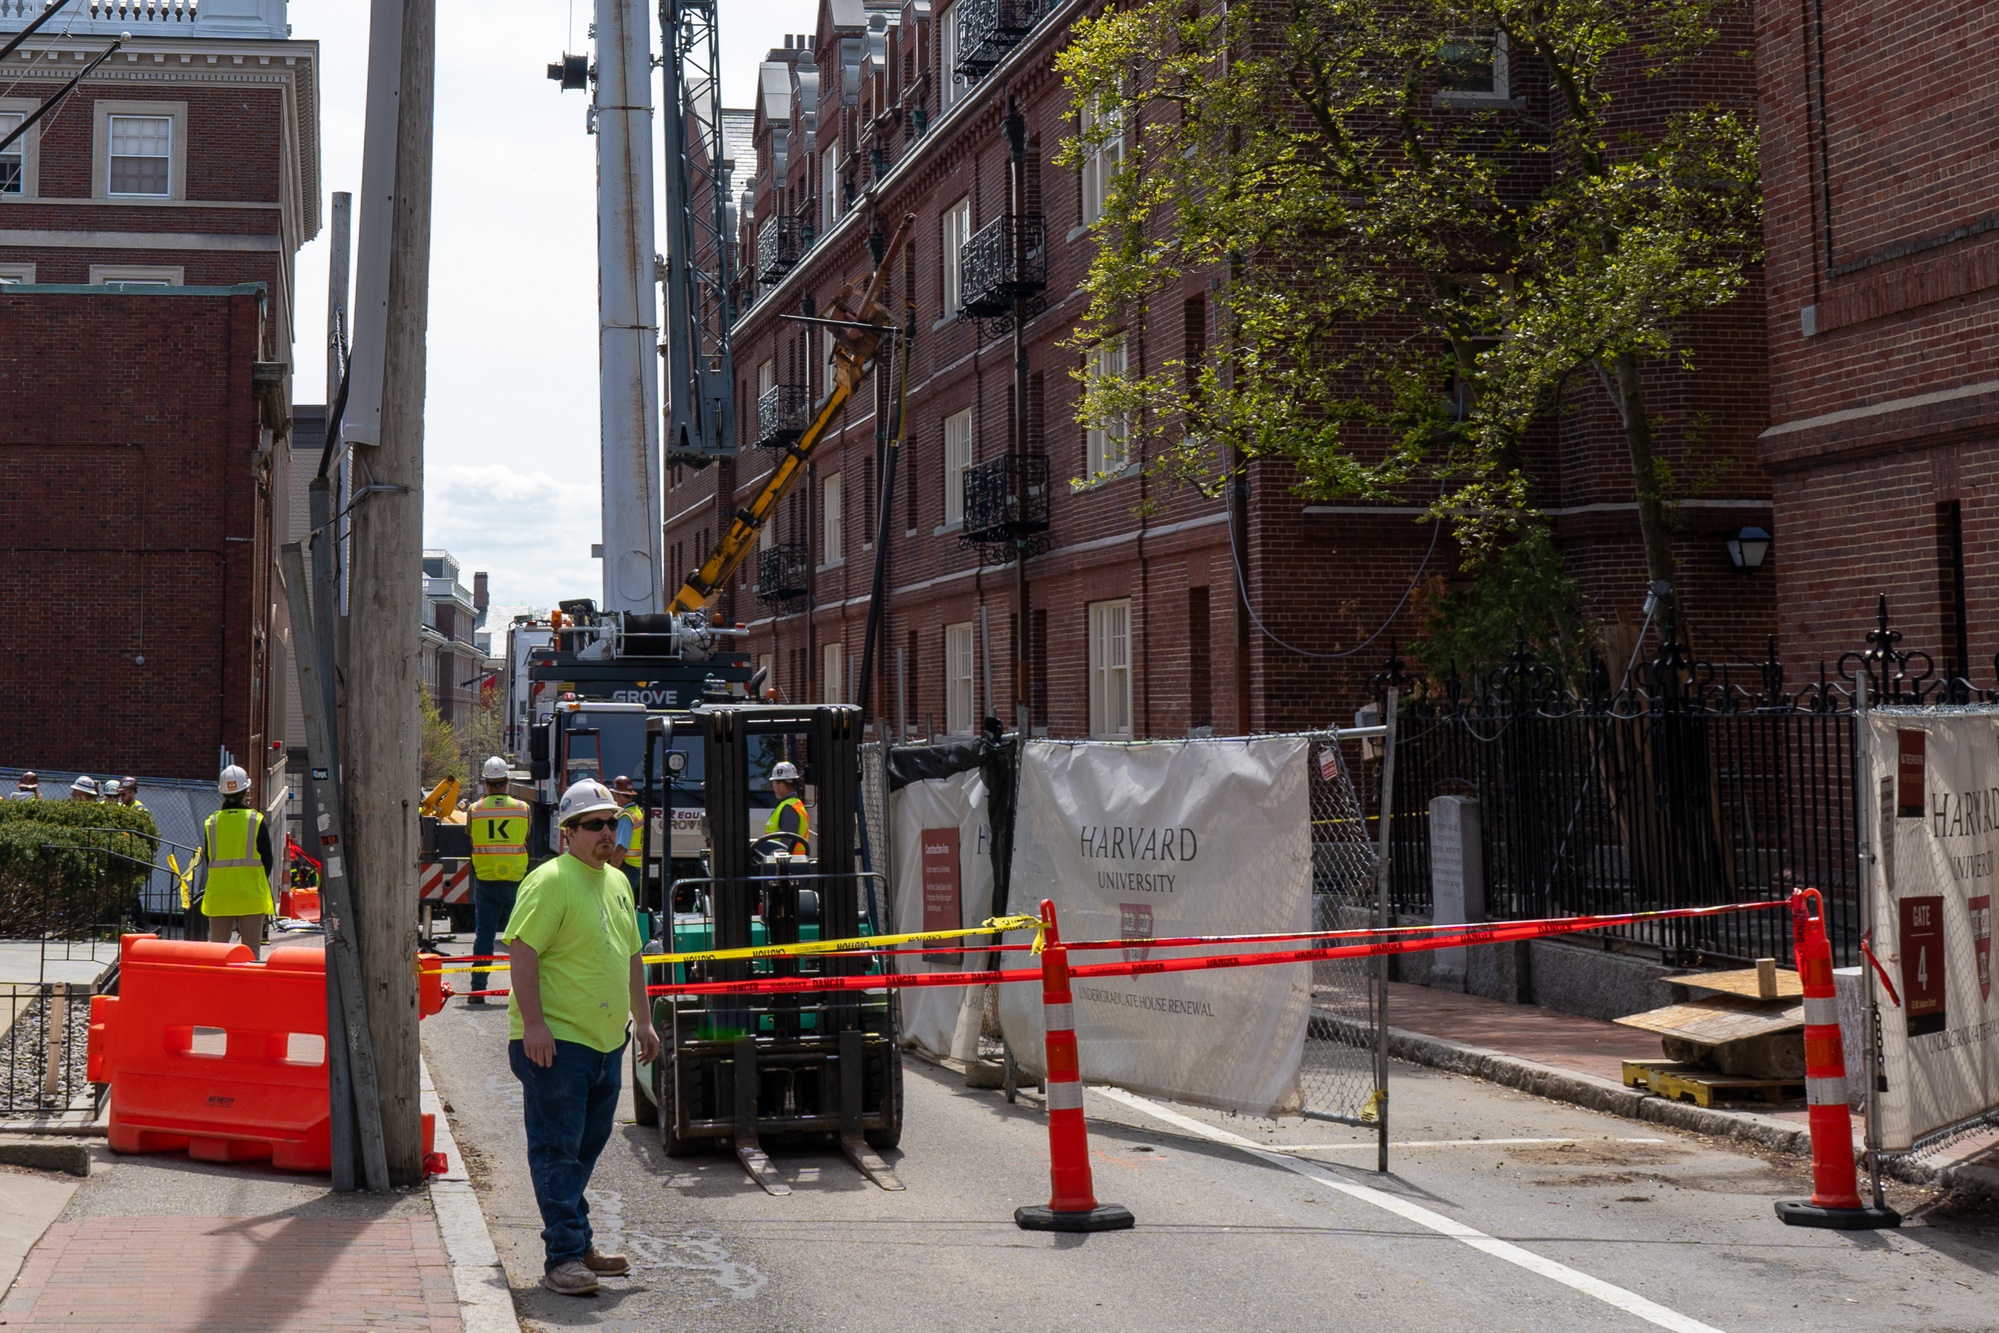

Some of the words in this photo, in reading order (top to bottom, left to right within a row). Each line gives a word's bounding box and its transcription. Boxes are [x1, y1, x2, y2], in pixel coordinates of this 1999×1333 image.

[612, 690, 677, 705] GROVE
[1080, 826, 1198, 861] HARVARD
[1097, 871, 1176, 893] UNIVERSITY
[1912, 905, 1931, 927] GATE
[726, 982, 759, 992] DANGER
[812, 978, 845, 989] DANGER
[885, 975, 918, 987] DANGER
[971, 971, 1004, 983] DANGER
[1370, 942, 1405, 954] DANGER
[1460, 932, 1496, 944] DANGER
[1537, 923, 1573, 935] DANGER
[1917, 945, 1928, 991] 4
[1078, 986, 1139, 1009] UNDERGRADUATE
[1139, 995, 1167, 1012] HOUSE
[1168, 1000, 1215, 1018] RENEWAL
